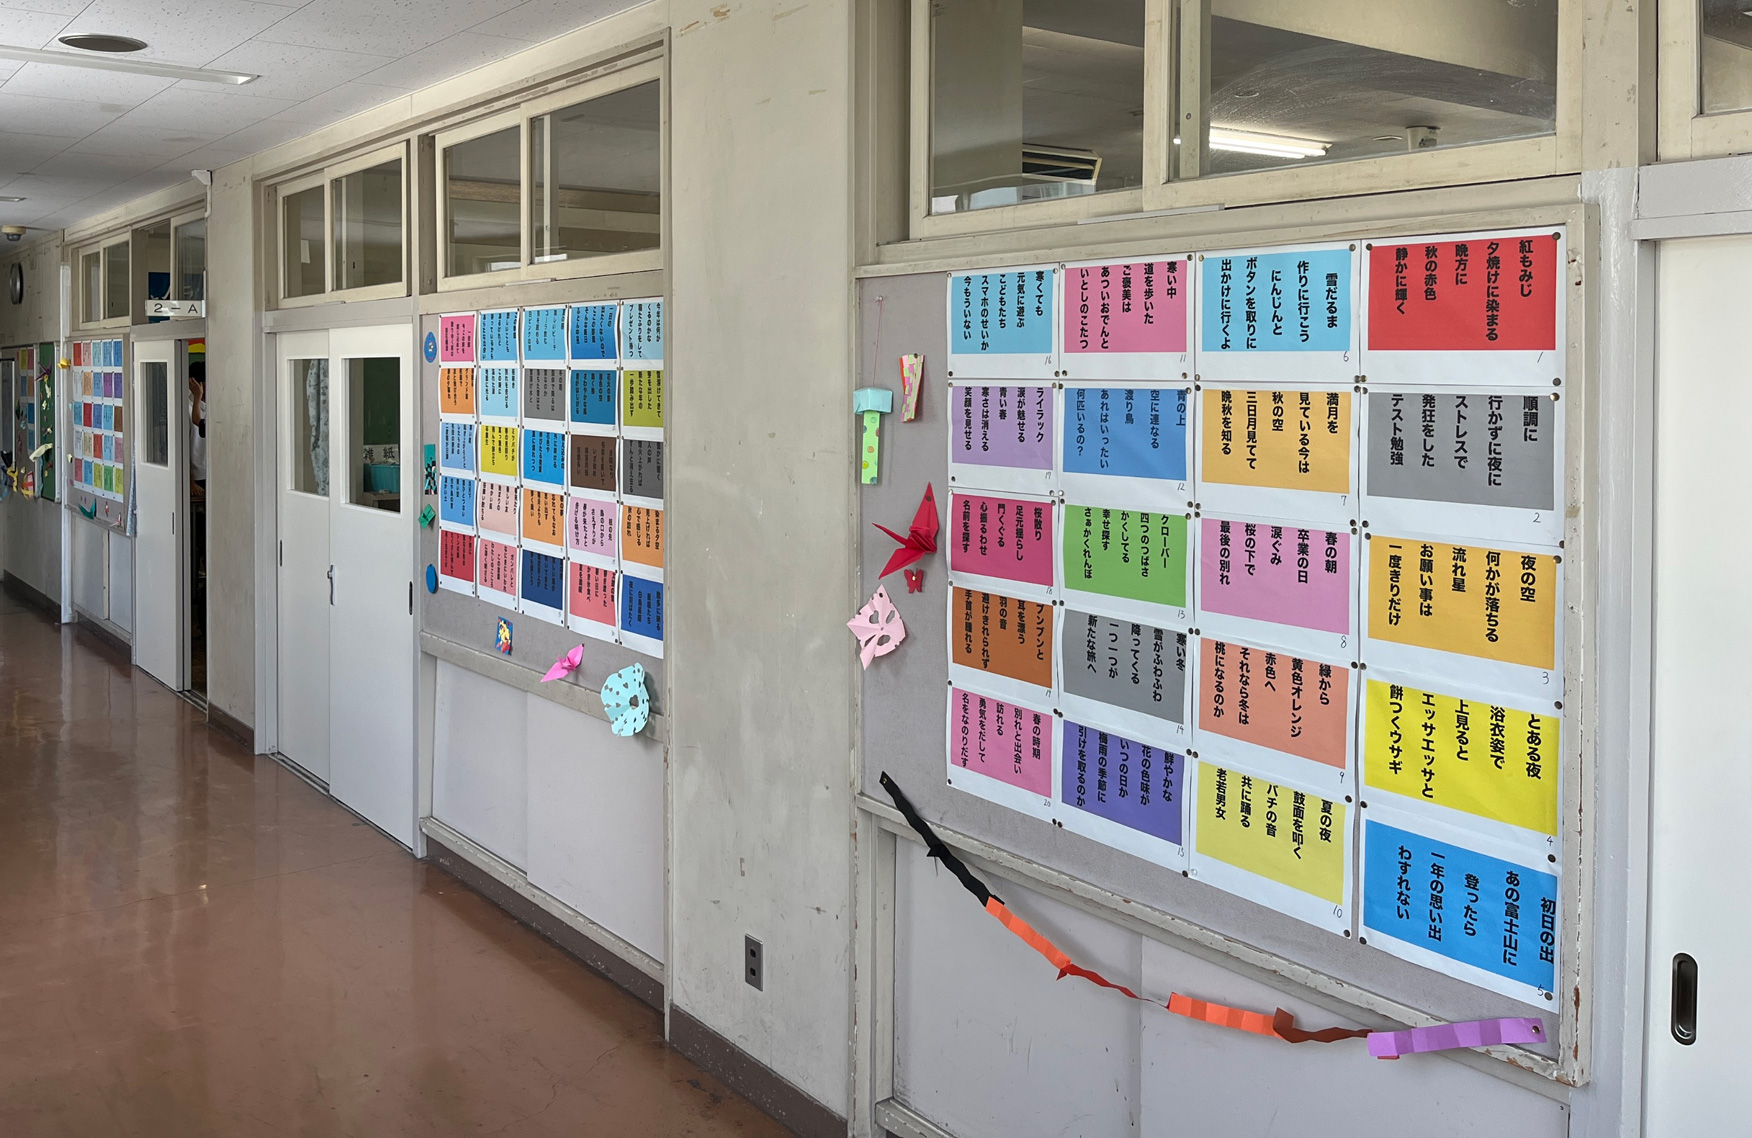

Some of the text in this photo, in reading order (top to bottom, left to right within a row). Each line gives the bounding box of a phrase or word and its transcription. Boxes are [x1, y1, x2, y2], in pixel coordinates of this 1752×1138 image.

[1035, 271, 1045, 317] 寒くても
[1121, 264, 1132, 313] ご褒美は
[1143, 263, 1154, 325] 道を歩いた
[1166, 262, 1178, 300] 寒い中
[1395, 246, 1409, 315] 静かに輝く
[1424, 245, 1438, 301] 秋の赤色
[1454, 243, 1469, 286] 晩方に
[1485, 241, 1501, 342] 夕焼けに染まる
[1518, 239, 1534, 298] 紅もみじ
[963, 275, 972, 340] 今もういない
[980, 275, 990, 351] スマホのせいか
[998, 273, 1007, 329] こどもたち
[1016, 272, 1026, 329] 元気に遊ぶ
[1079, 268, 1090, 350] いとしのこたつ
[1100, 266, 1110, 350] あついおでんと
[1220, 258, 1232, 350] 出かけに行くよ
[1245, 256, 1258, 350] ボタンを取りに
[1270, 269, 1283, 336] にんじんと
[1297, 260, 1310, 343] 作りに行こう
[1325, 272, 1338, 329] 雪だるま
[963, 387, 973, 451] 笑顔を見せる
[981, 387, 990, 452] 寒さは消える
[998, 387, 1008, 421] 青い春
[1017, 387, 1026, 443] 涙が魅せる
[1036, 387, 1045, 443] ライラック
[1100, 389, 1110, 469] あれはいったい
[1124, 390, 1134, 425] 渡り鳥
[1150, 390, 1160, 449] 空に連なる
[1176, 390, 1187, 426] 青の上
[1221, 390, 1233, 456] 晩秋を知る
[1246, 391, 1258, 470] 三日月見てて
[1271, 391, 1284, 432] 秋の空
[1298, 392, 1311, 474] 見ている今は
[1326, 393, 1340, 434] 満月を
[1390, 394, 1404, 466] テスト勉強
[1421, 395, 1436, 468] 発狂をした
[1453, 395, 1469, 470] ストレスで
[1523, 397, 1539, 442] 順調に
[1487, 396, 1503, 487] 行かずに夜に
[962, 499, 971, 553] 名前を探す
[997, 503, 1006, 548] 門くぐる
[1033, 506, 1043, 542] 桜散り
[1082, 507, 1093, 579] さぁかくれんぼ
[1101, 509, 1111, 551] 幸せ探す
[1120, 511, 1130, 564] かくしてる
[1140, 513, 1150, 578] 四つのつばさ
[1160, 515, 1170, 569] クローバー
[1219, 521, 1231, 586] 最後の別れ
[1244, 524, 1256, 576] 桜の下で
[1270, 527, 1283, 566] 涙ぐみ
[1324, 533, 1338, 574] 春の朝
[1297, 530, 1310, 584] 卒業の日
[1388, 544, 1403, 627] 一度きりだけ
[1419, 543, 1434, 617] お願い事は
[1451, 546, 1467, 593] 流れ星
[1520, 554, 1537, 603] 夜の空
[999, 596, 1008, 631] 羽の音
[1485, 550, 1501, 643] 何かが落ちる
[1086, 616, 1098, 674] 新たな旅へ
[1108, 622, 1119, 679] 一つ一つが
[1130, 625, 1141, 685] 降ってくる
[1152, 629, 1164, 702] 雪がふわふわ
[1175, 634, 1187, 672] 寒い冬
[1264, 652, 1277, 692] 赤色へ
[1213, 642, 1226, 718] 桃になるのか
[1238, 647, 1251, 726] それなら冬は
[1290, 658, 1304, 738] 黄色オレンジ
[1318, 664, 1332, 706] 緑から
[960, 692, 970, 767] 名をなのりだす
[978, 697, 987, 763] 勇気をだして
[996, 702, 1005, 736] 訪れる
[1013, 707, 1023, 774] 別れと出会い
[1032, 713, 1041, 760] 春の時期
[1420, 692, 1436, 799] エッサエッサと
[1454, 699, 1470, 762] 上見ると
[1489, 706, 1506, 770] 浴衣姿で
[1525, 714, 1542, 780] とある夜
[1076, 727, 1087, 807] 引けを取るのか
[1097, 732, 1109, 804] 梅雨の季節に
[1118, 739, 1130, 798] いつの日か
[1140, 745, 1152, 806] 花の色味が
[1162, 752, 1175, 802] 鮮やかな
[1215, 768, 1227, 821] 老若男女
[1240, 776, 1253, 828] 共に踊る
[1265, 784, 1279, 838] バチの音
[1292, 791, 1306, 860] 鼓面を叩く
[1319, 800, 1333, 843] 夏の夜
[1396, 845, 1412, 920] わすれない
[1428, 852, 1445, 942] 一年の思い出
[1463, 873, 1480, 937] 登ったら
[1502, 870, 1521, 967] あの富士山に
[1539, 896, 1556, 965] 初日の出
